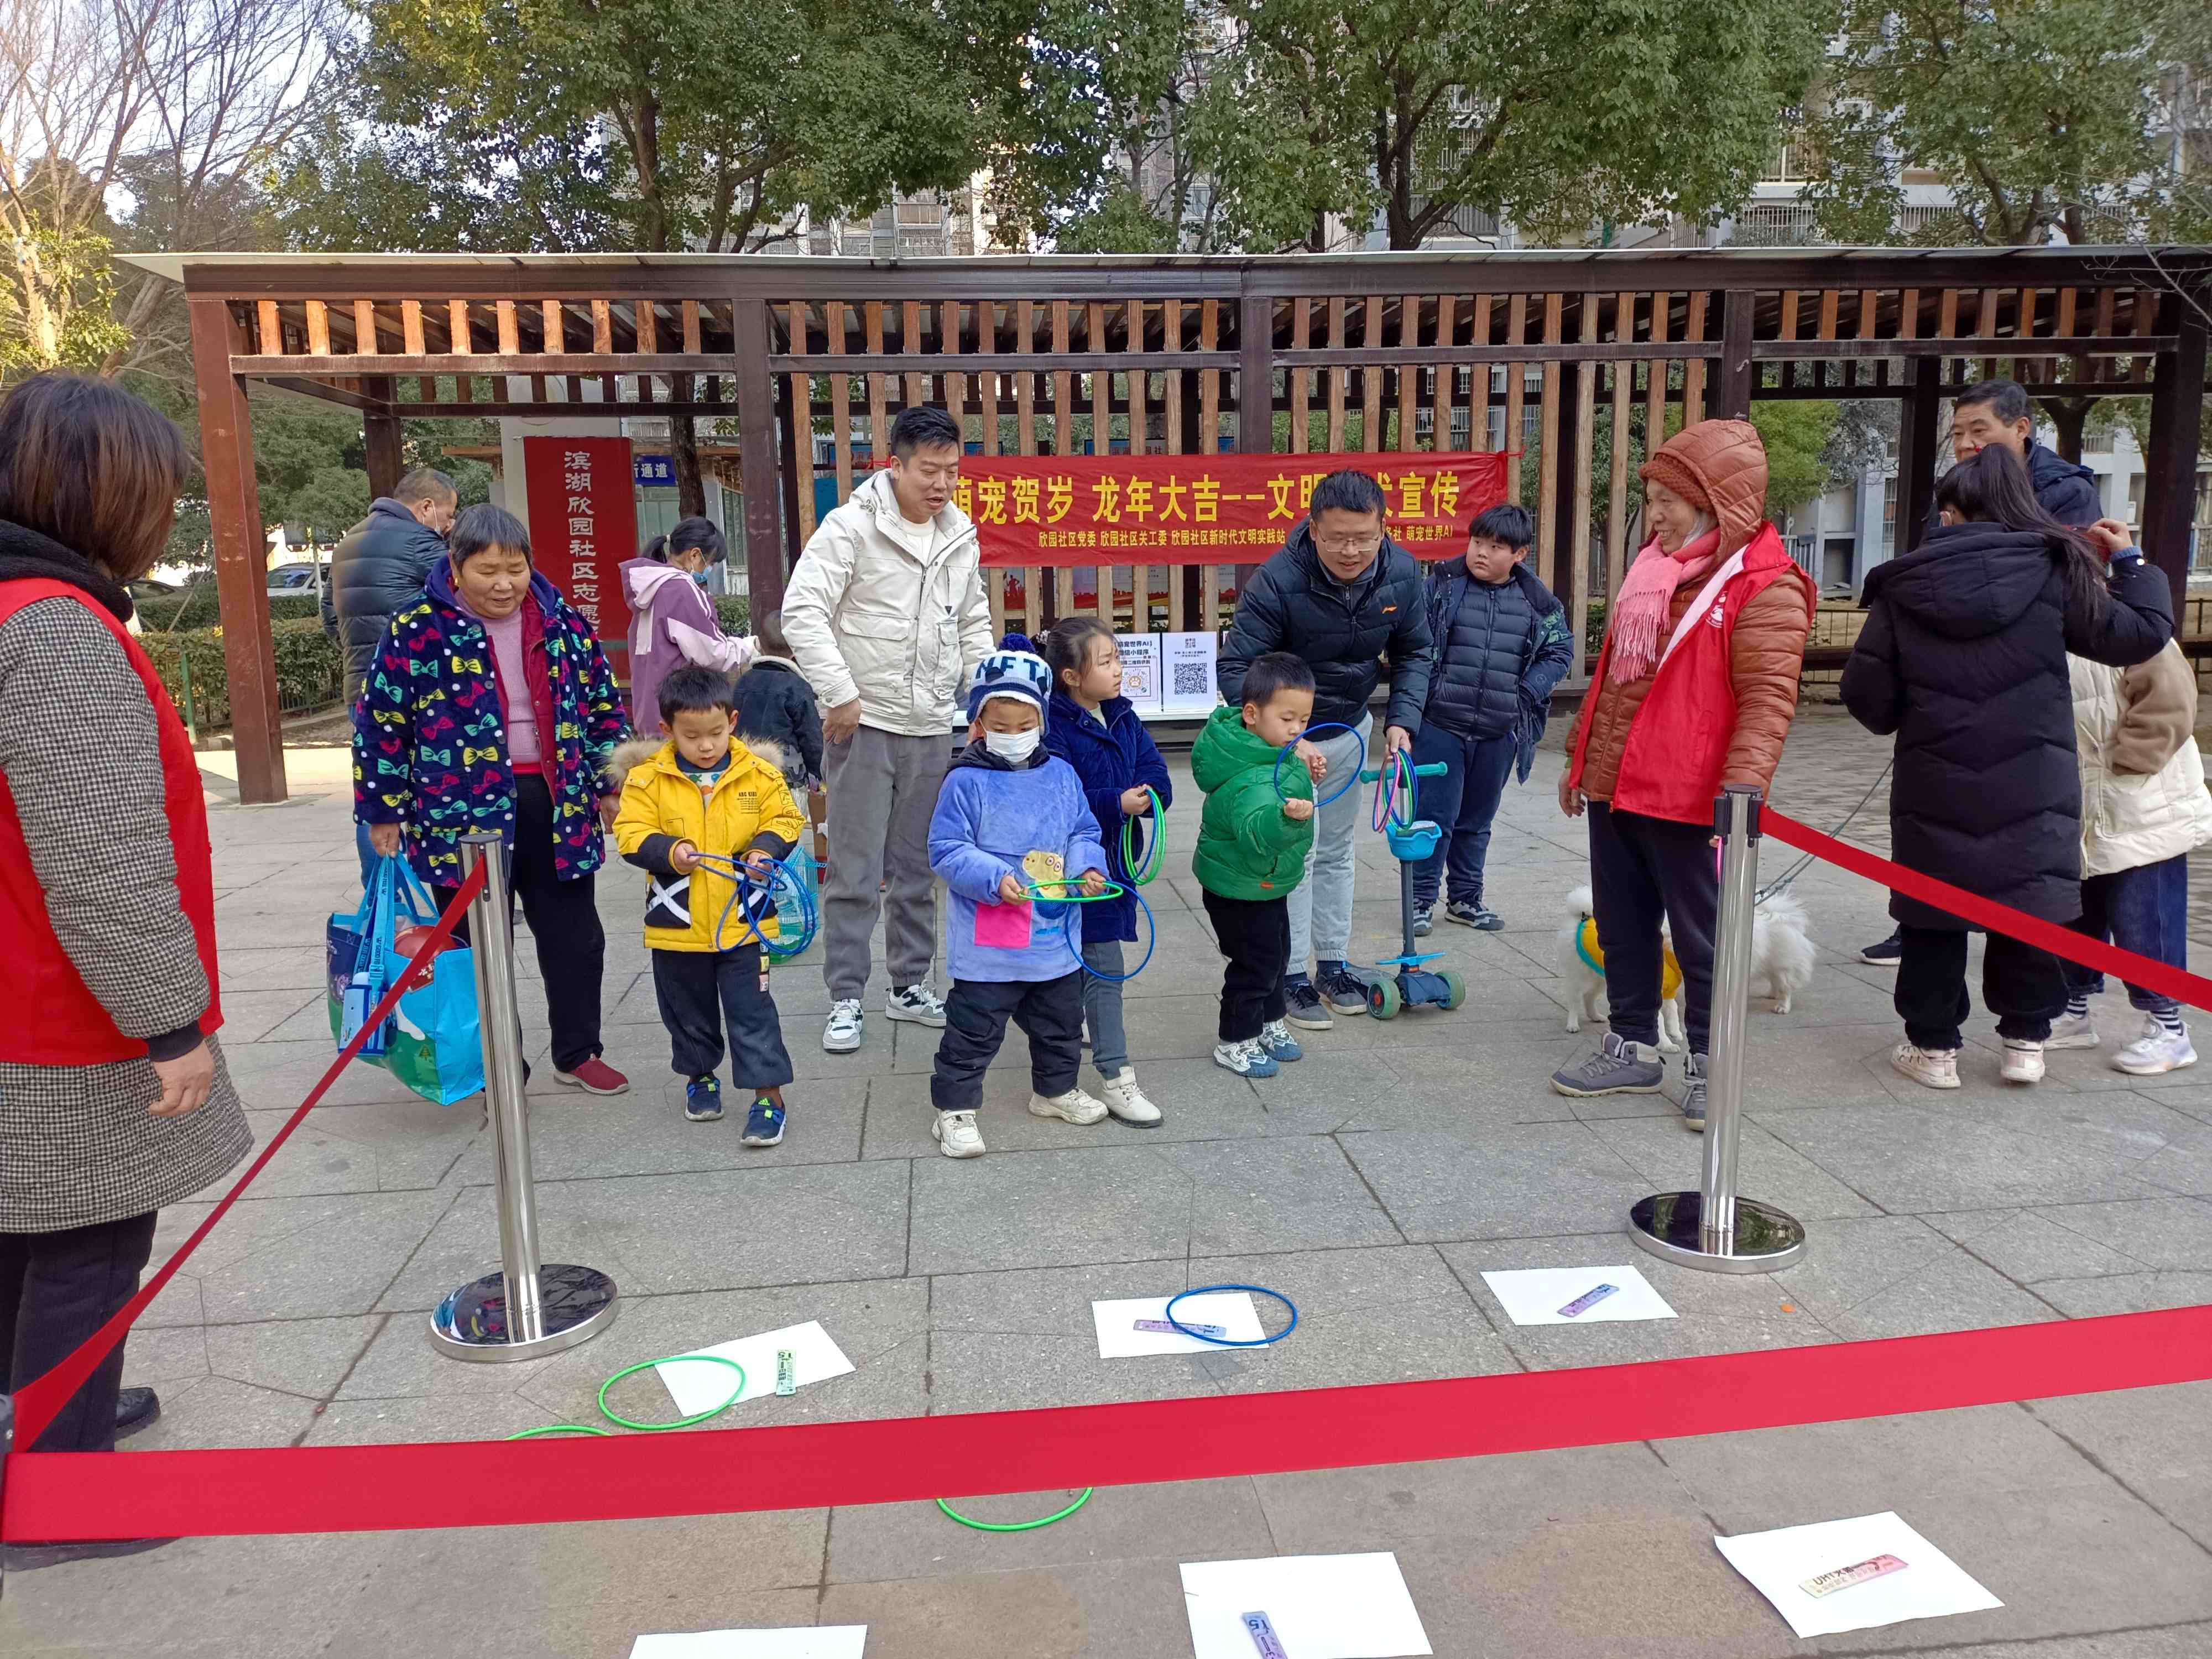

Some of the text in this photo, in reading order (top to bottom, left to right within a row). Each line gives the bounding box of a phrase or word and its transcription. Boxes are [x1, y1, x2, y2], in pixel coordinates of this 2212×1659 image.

[564, 451, 601, 636] 滨湖欣园社区志愿
[1039, 530, 1096, 547] 欣园社区党委
[1100, 529, 1167, 547] 欣园社区关工委
[1171, 528, 1286, 546] 欣园社区新时代文明实践站
